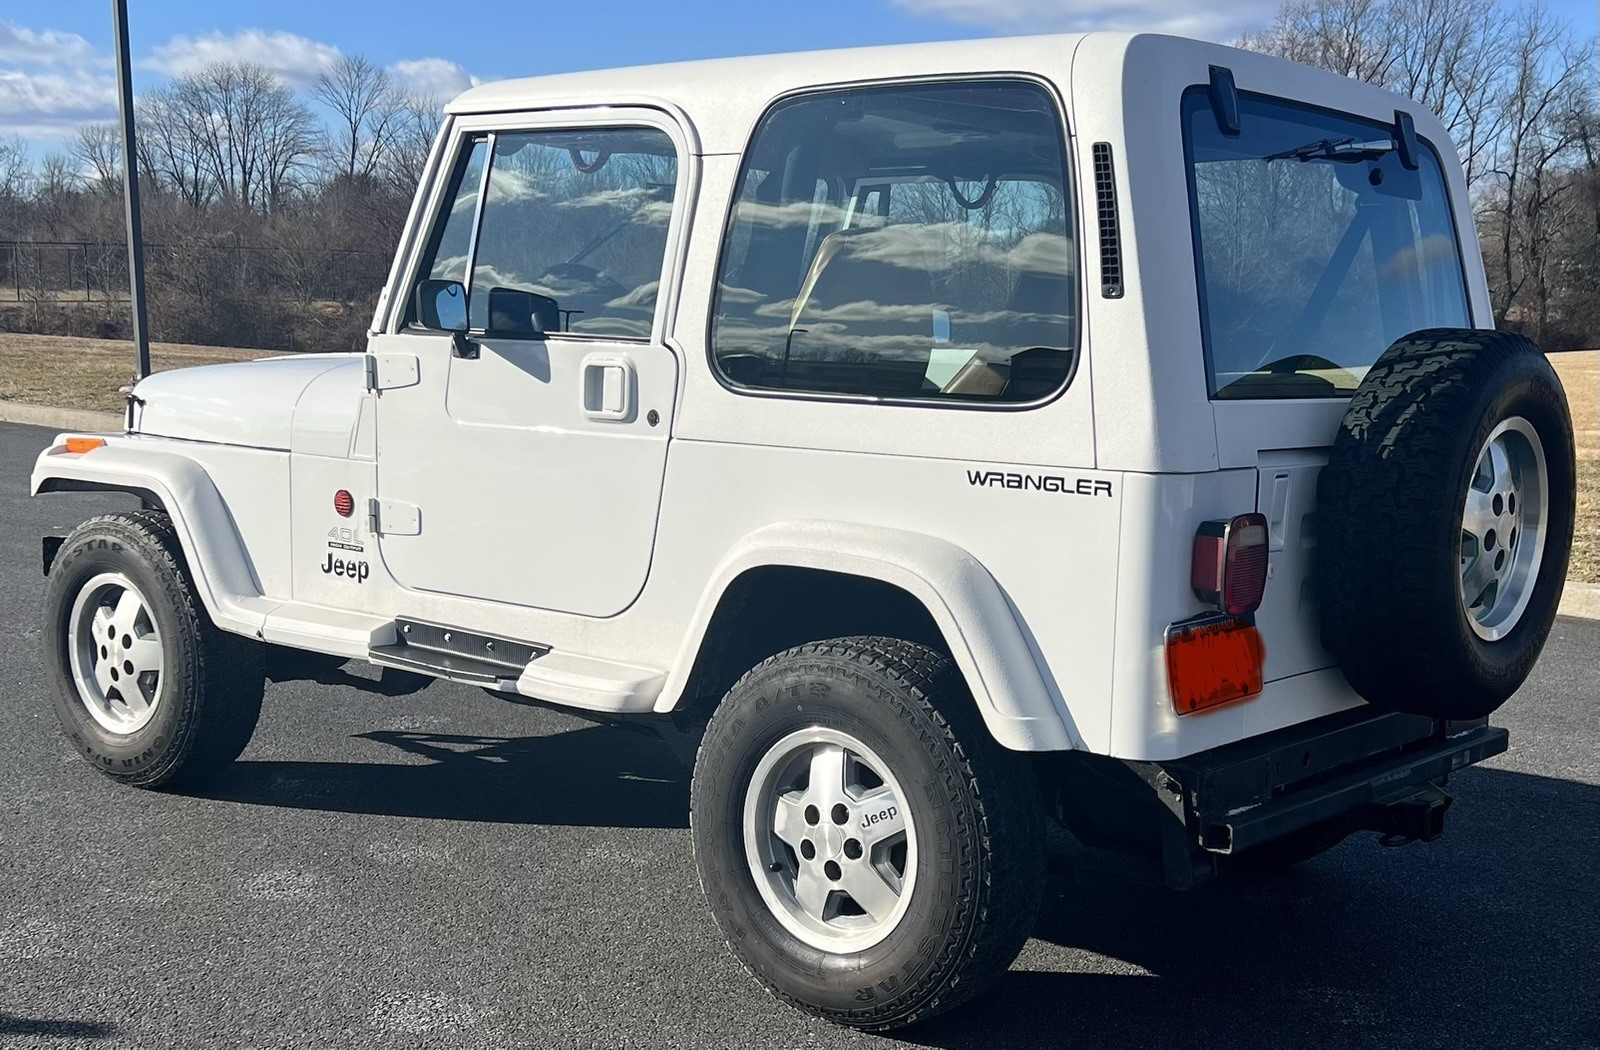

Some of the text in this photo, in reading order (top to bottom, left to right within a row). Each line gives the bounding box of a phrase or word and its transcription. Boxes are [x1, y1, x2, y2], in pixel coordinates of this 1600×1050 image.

[966, 469, 1113, 498] WRANGLER
[320, 552, 370, 584] Jeep
[860, 805, 898, 829] Jeep
